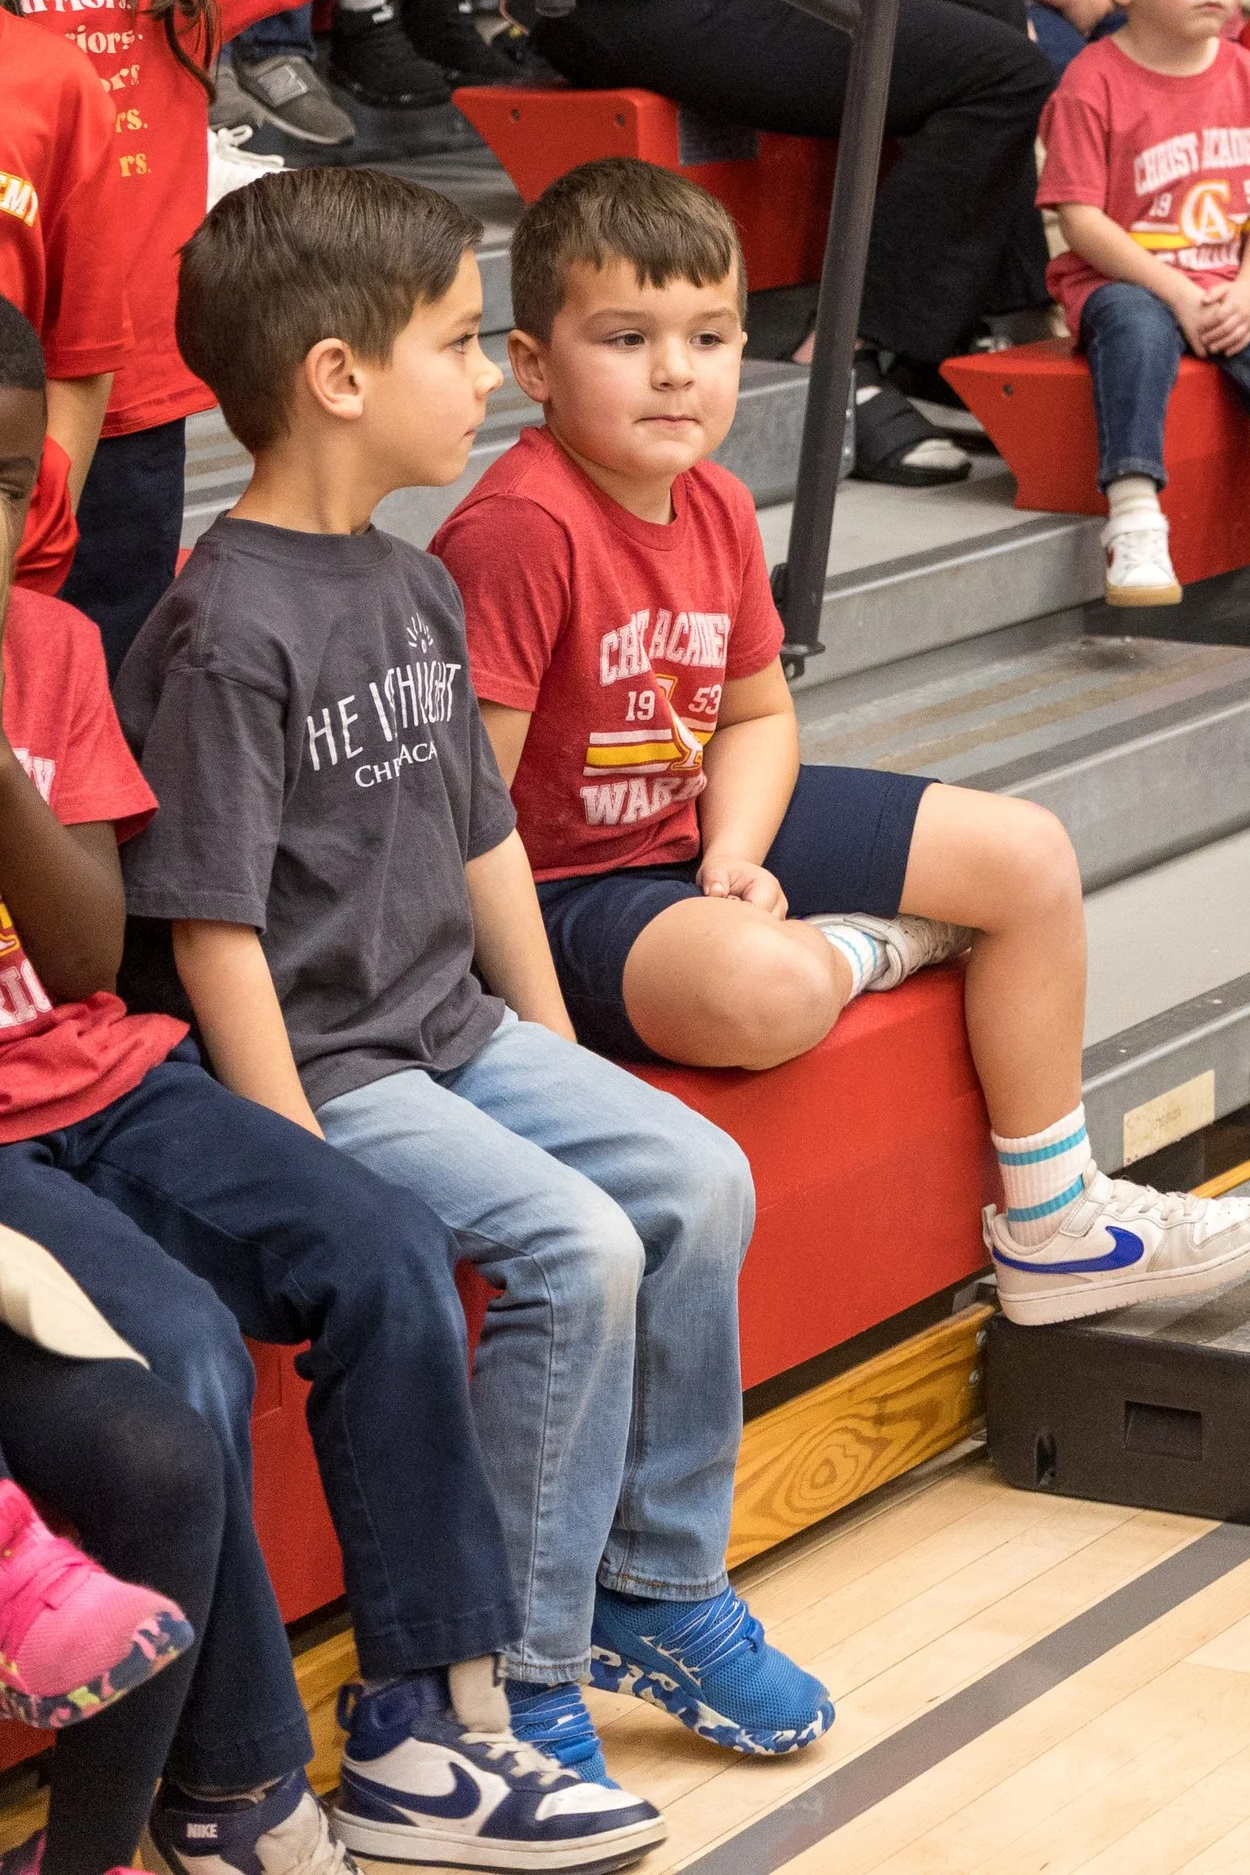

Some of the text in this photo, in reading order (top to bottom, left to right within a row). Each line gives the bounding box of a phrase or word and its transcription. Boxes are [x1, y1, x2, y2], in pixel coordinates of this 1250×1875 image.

[625, 683, 722, 722] 19 53
[306, 694, 364, 772] HE
[186, 1823, 218, 1839] NIKE
